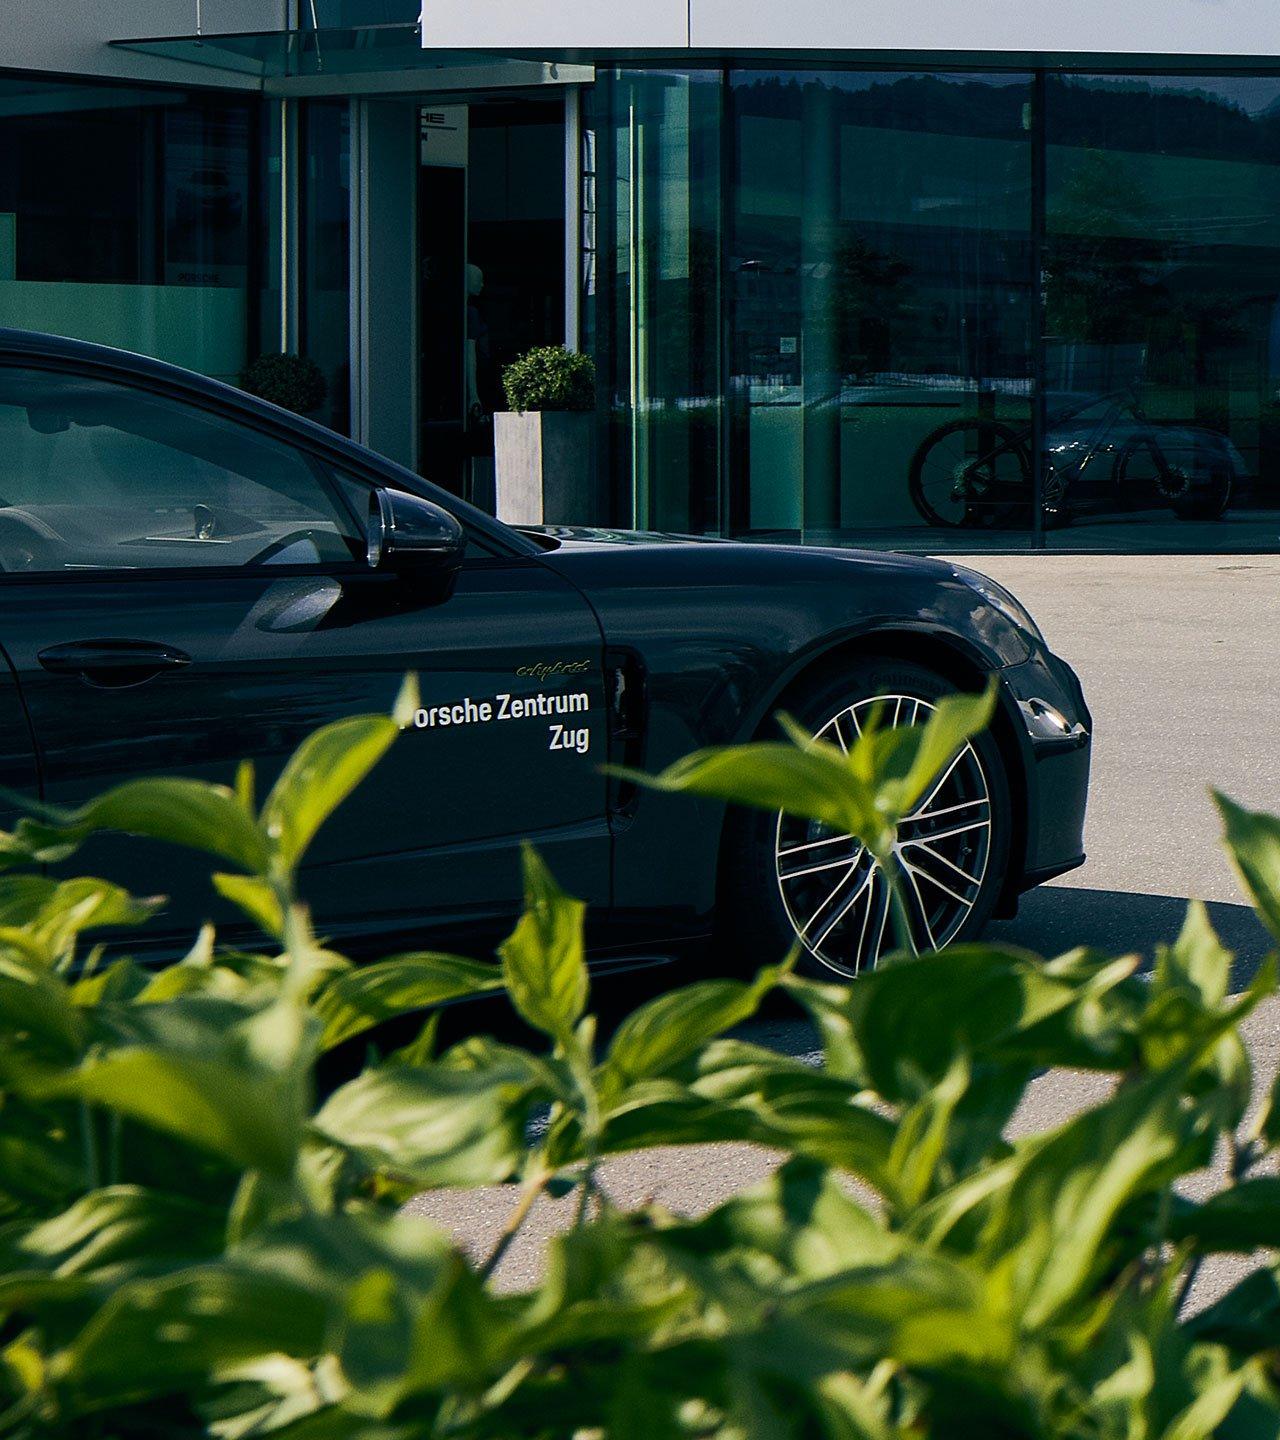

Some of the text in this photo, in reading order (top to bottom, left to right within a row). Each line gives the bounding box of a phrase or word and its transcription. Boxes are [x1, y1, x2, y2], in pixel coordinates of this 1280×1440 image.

[399, 692, 590, 730] orsche Zentrum
[549, 724, 590, 754] Zug
